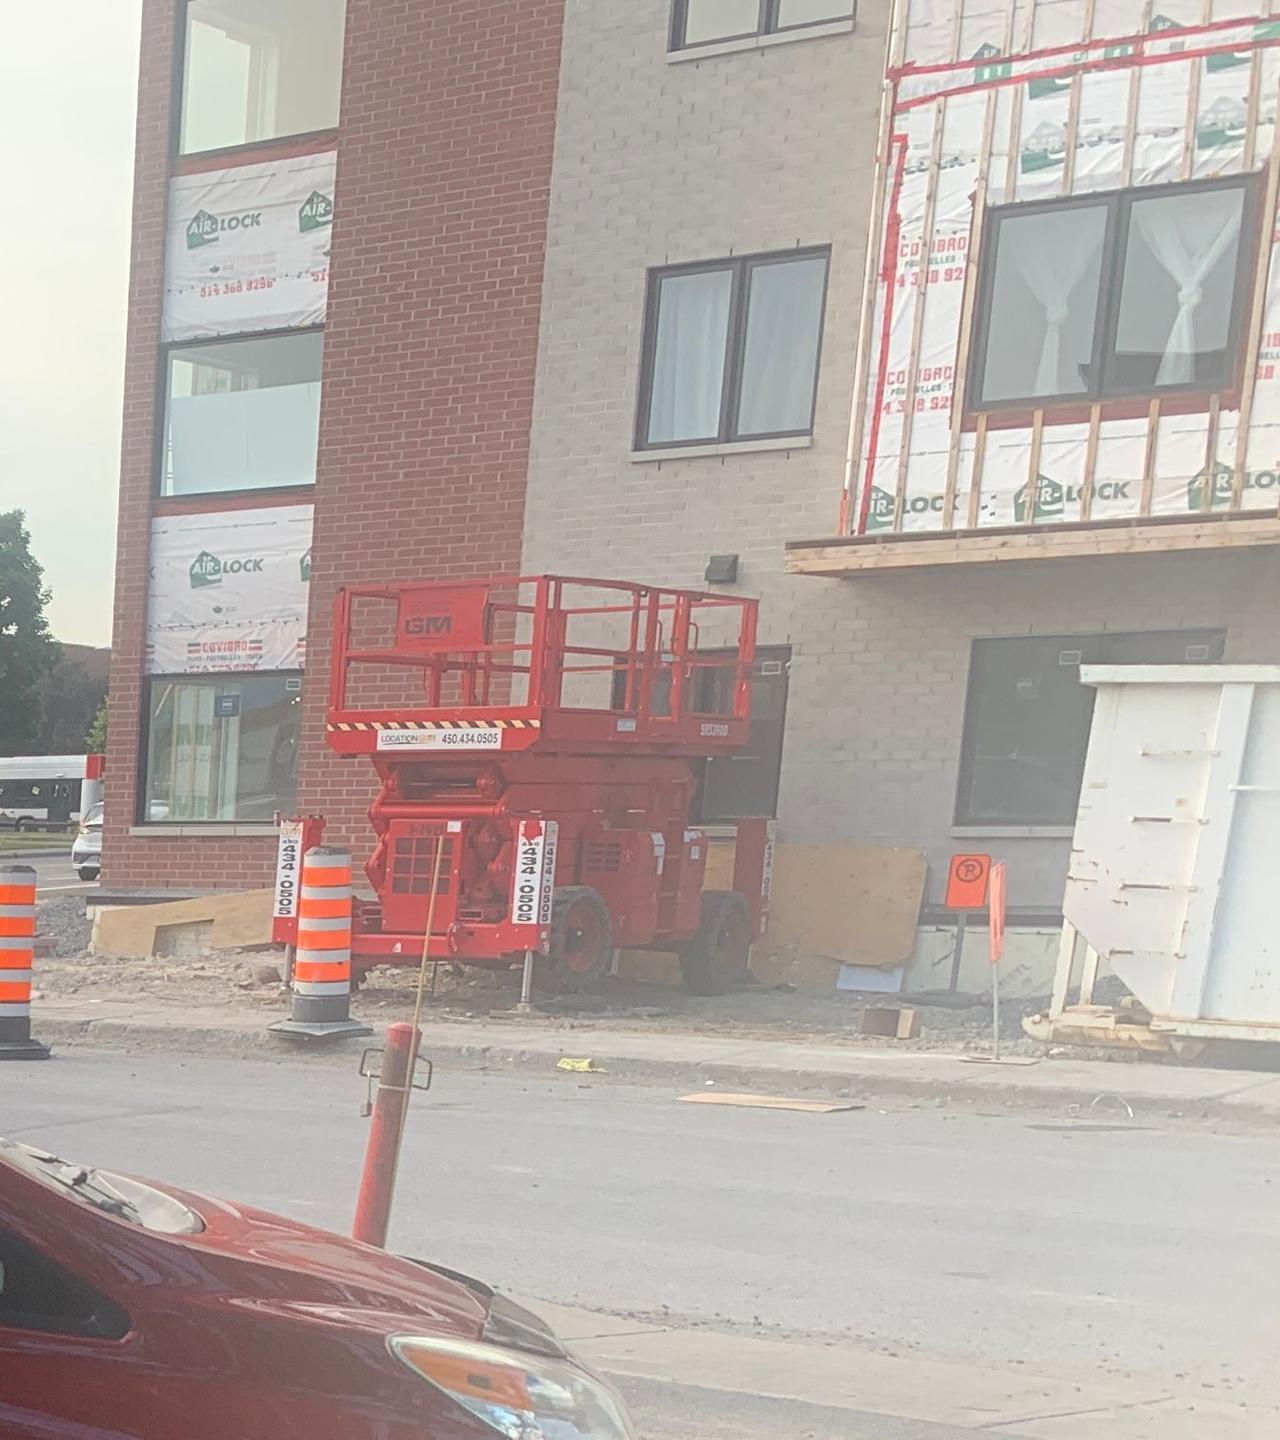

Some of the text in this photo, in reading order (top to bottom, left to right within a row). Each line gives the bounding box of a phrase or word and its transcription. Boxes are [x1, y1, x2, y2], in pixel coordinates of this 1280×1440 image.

[900, 236, 967, 258] COIBRO
[192, 558, 264, 575] AIR-LOCK
[406, 616, 452, 634] GM
[381, 733, 418, 743] LOCATION
[442, 733, 499, 745] 450.434.0505
[516, 847, 538, 922] 434-0505
